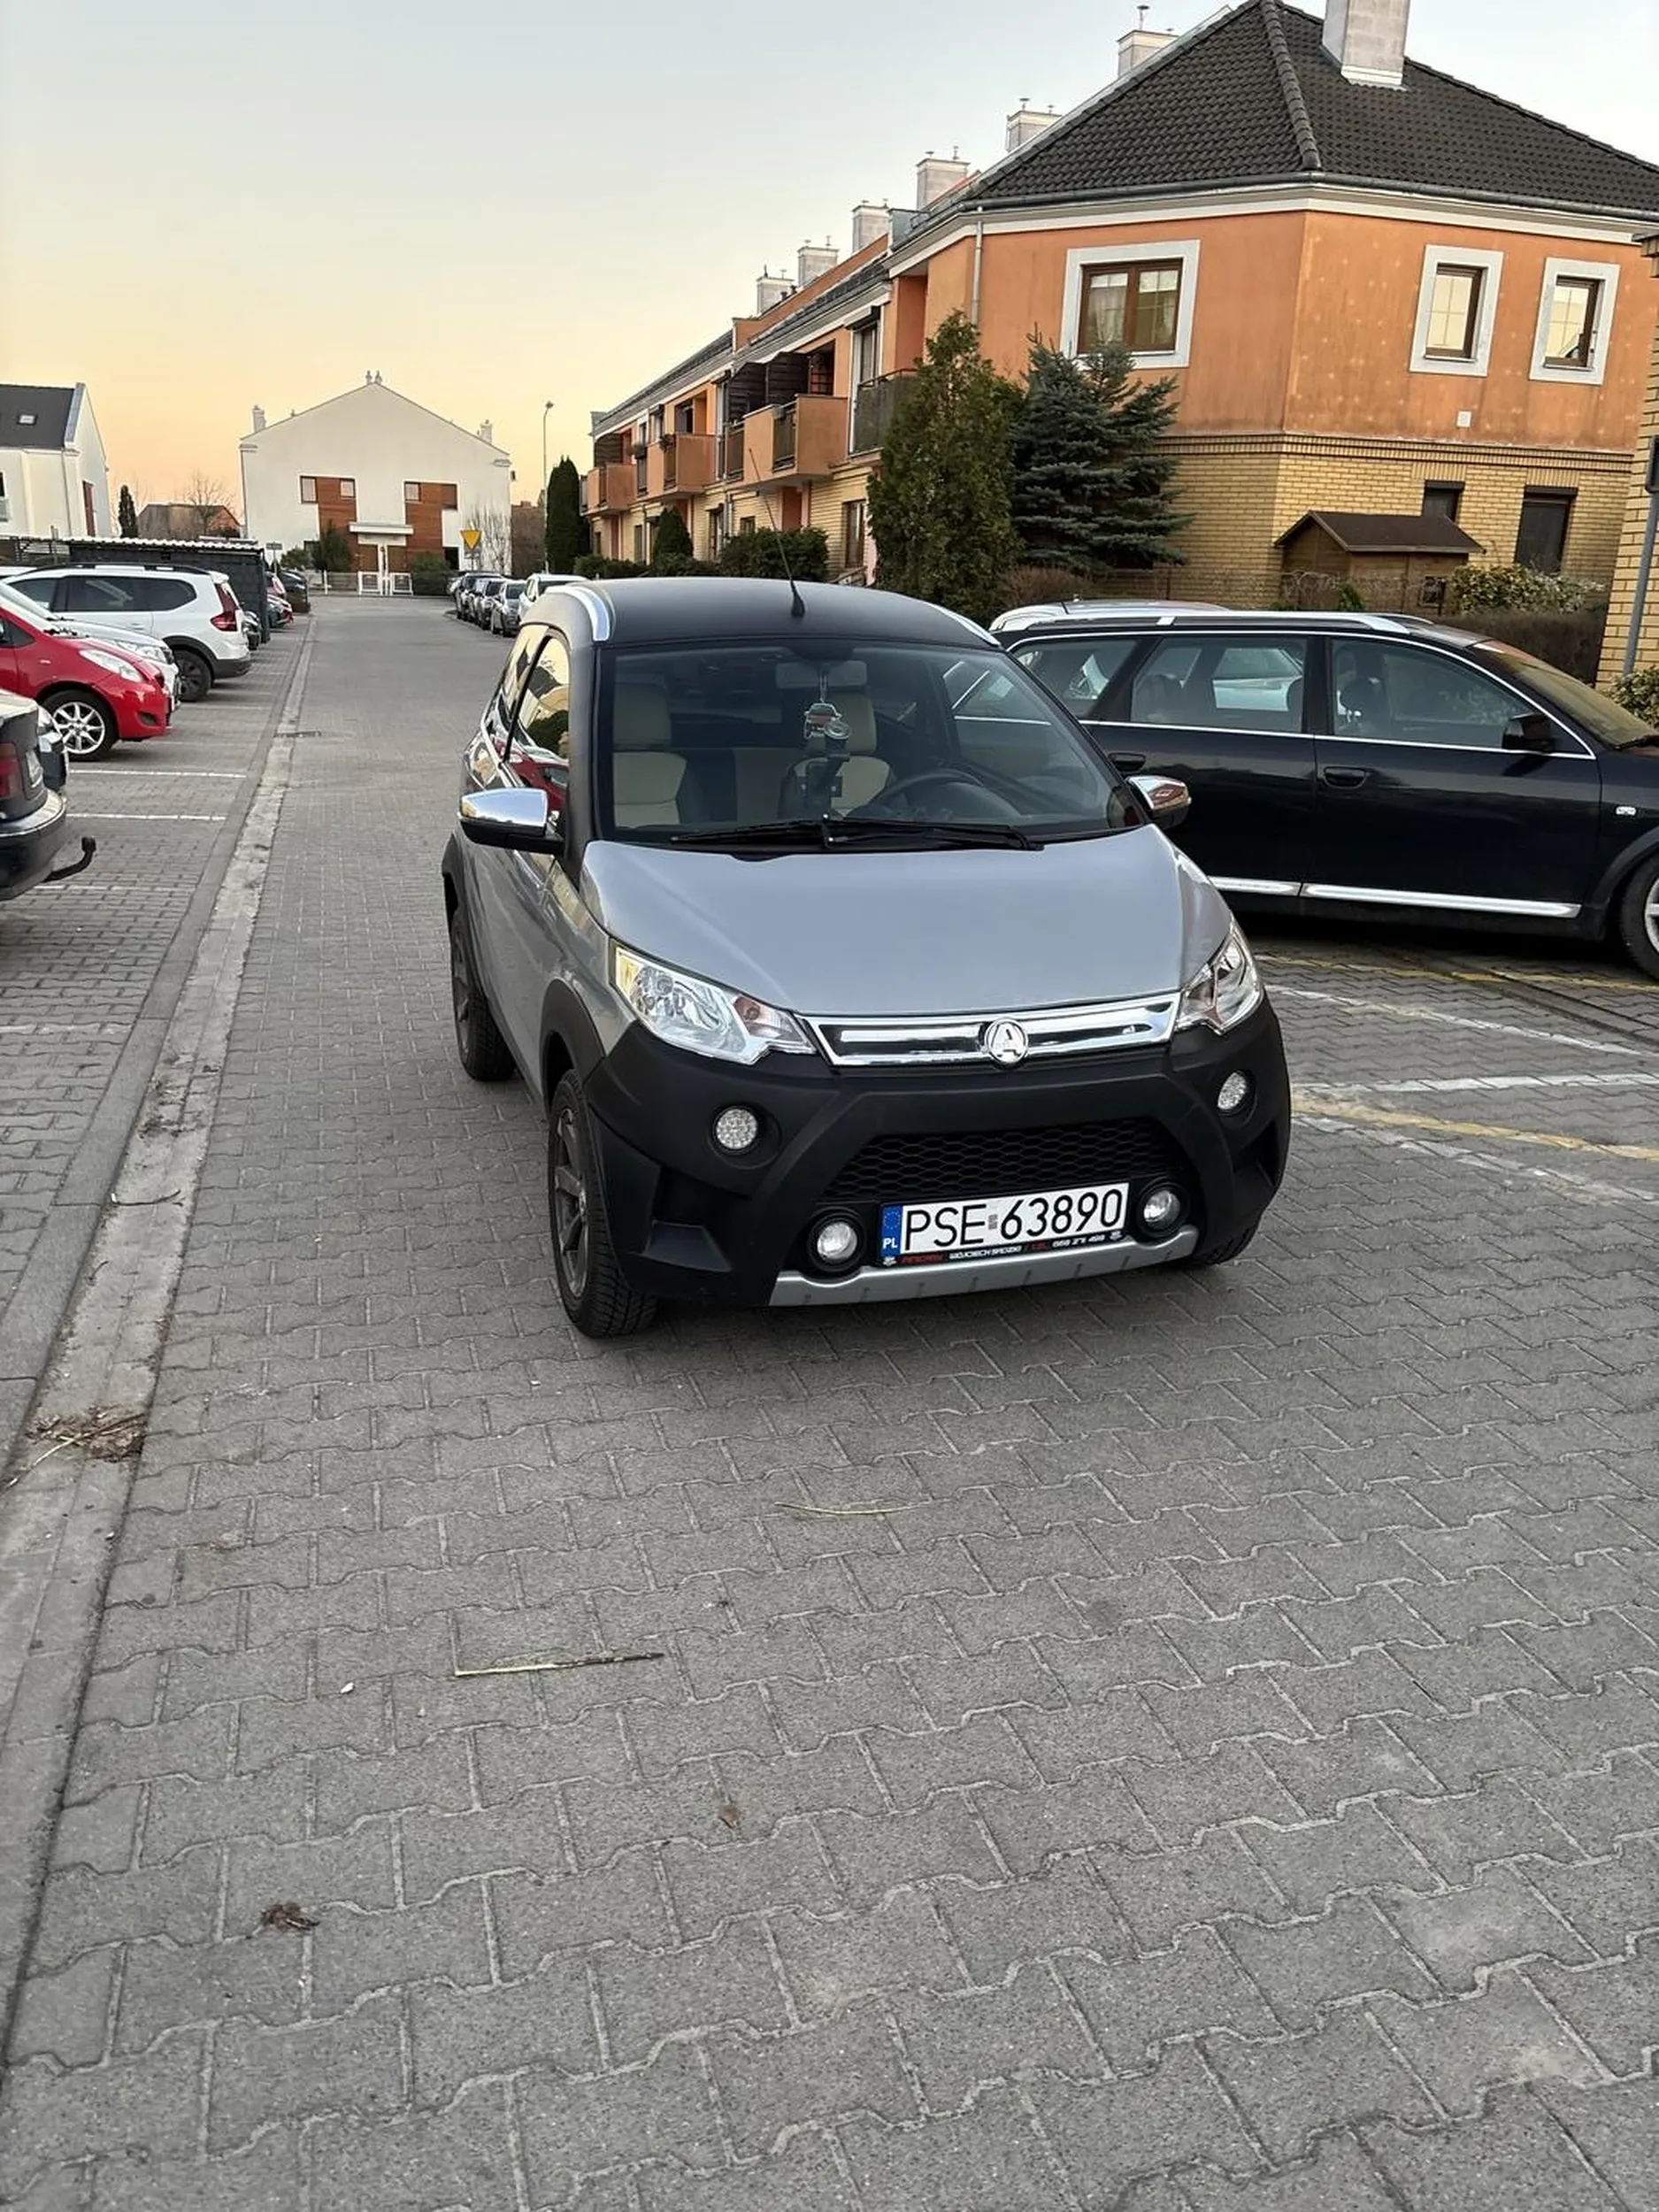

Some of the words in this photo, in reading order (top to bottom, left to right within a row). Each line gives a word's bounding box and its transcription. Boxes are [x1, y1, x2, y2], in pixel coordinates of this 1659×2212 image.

[904, 1203, 987, 1251] PSE
[1000, 1188, 1122, 1240] 63890
[882, 1238, 898, 1248] PL
